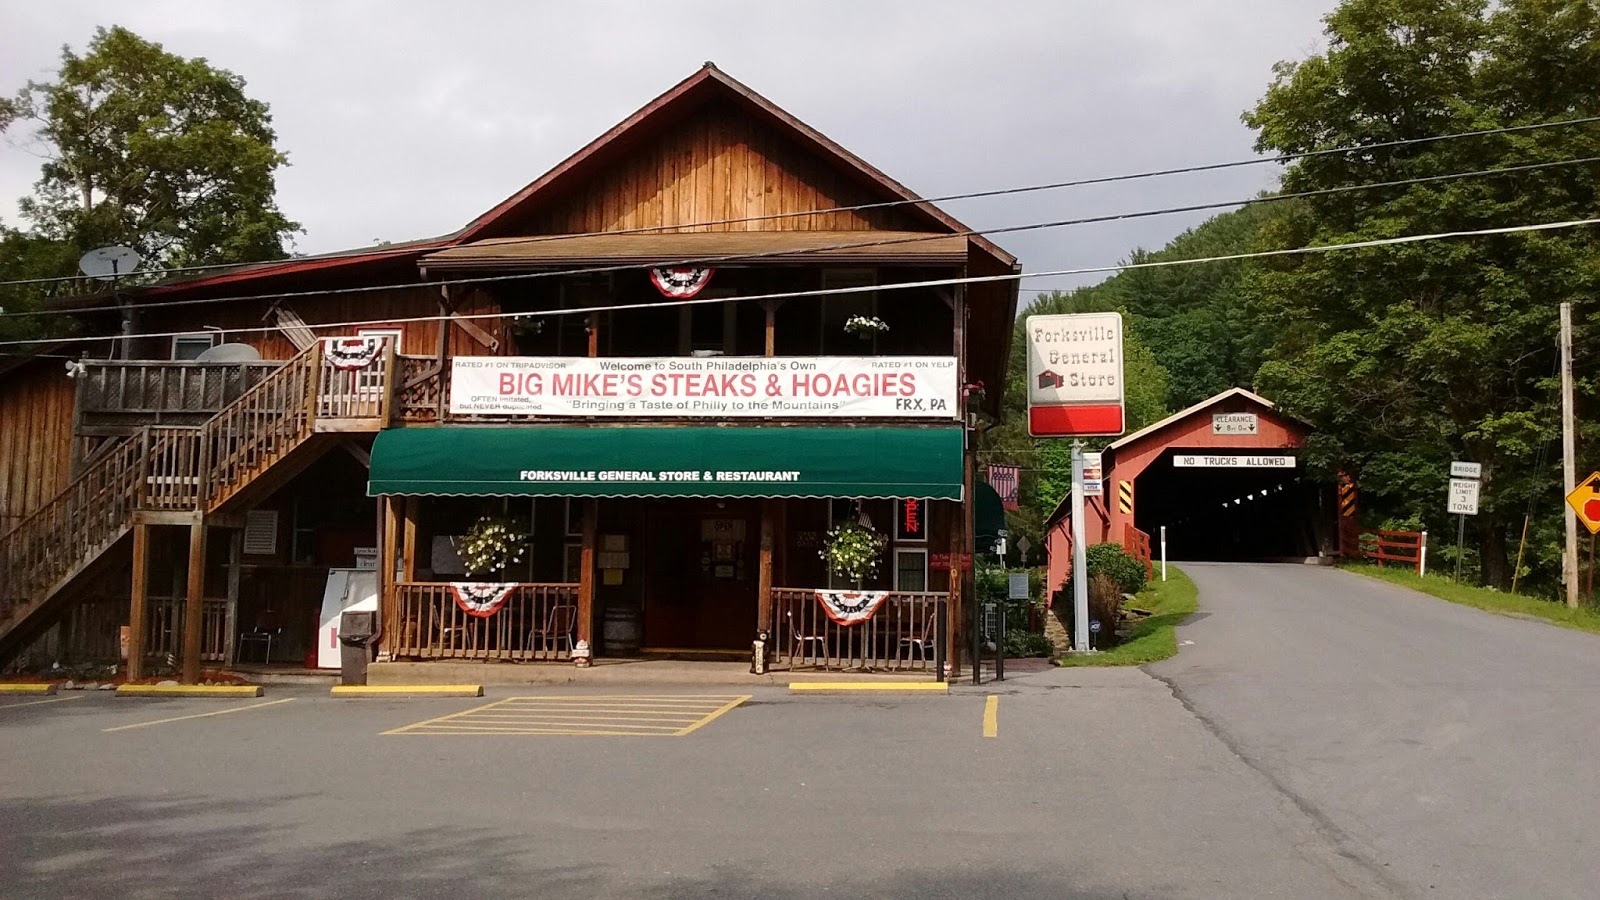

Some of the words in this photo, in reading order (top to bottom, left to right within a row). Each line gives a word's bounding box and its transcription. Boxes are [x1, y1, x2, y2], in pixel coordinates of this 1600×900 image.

[1034, 326, 1114, 343] Forksville
[1049, 348, 1115, 365] General
[455, 361, 483, 369] RATED
[511, 362, 567, 370] TRIPADVISOR
[600, 361, 652, 371] Welcome
[654, 362, 666, 371] to
[668, 361, 703, 371] South
[706, 361, 787, 372] Philadelphia's
[790, 361, 817, 371] Own
[500, 373, 543, 396] BIG
[552, 373, 643, 397] MIKE'S
[651, 373, 757, 397] STEAKS
[765, 374, 783, 397] &
[792, 373, 916, 397] HOAGIES
[1069, 372, 1115, 387] Store
[566, 400, 625, 412] "Bringing
[628, 402, 636, 410] a
[640, 400, 673, 410] Taste
[676, 400, 689, 410] of
[693, 400, 727, 412] Philly
[732, 401, 745, 410] to
[748, 400, 768, 410] the
[772, 400, 846, 410] Mountains"
[895, 398, 927, 412] FRX,
[930, 399, 947, 410] PA
[1216, 415, 1253, 423] CLEARANCE
[1183, 457, 1195, 466] NO
[1204, 457, 1238, 466] TRUCKS
[1246, 457, 1286, 466] ALLOWED
[520, 470, 596, 481] FORKSVILLE
[598, 471, 656, 481] GENERAL
[659, 471, 700, 481] STORE
[703, 471, 713, 481] &
[716, 471, 800, 482] RESTAURANT
[1460, 495, 1466, 503] 3
[1453, 503, 1474, 511] TONS
